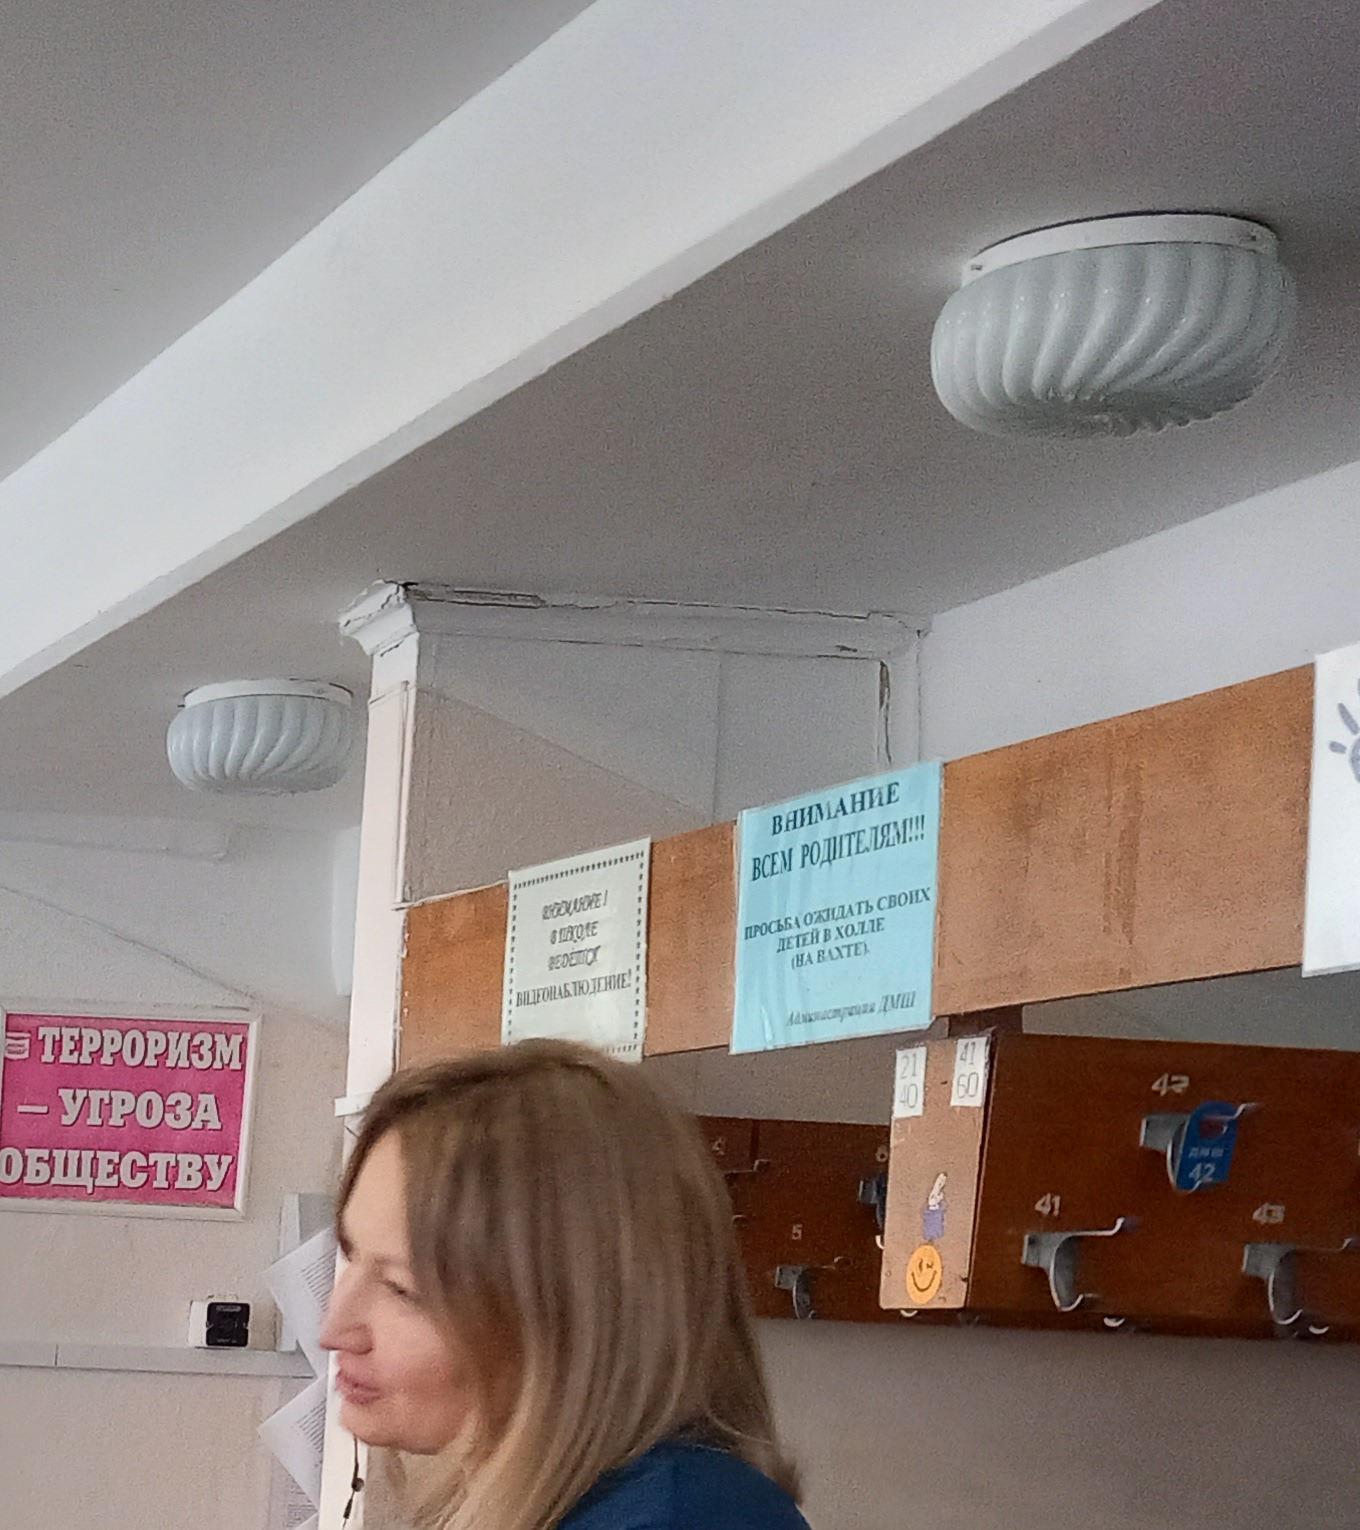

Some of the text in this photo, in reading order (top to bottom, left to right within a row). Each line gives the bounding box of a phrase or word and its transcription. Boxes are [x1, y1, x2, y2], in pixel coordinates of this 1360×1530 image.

[771, 781, 900, 836] ВНИМАНИЕ
[752, 814, 925, 882] ВСЕМ РОДИТЕЛЯМ!!!
[744, 887, 931, 940] ПРОСЬБА ОЖИДАТЬ СВОИХ
[777, 917, 886, 953] ДЕТЕЙ В ХОЛЛЕ
[791, 950, 814, 970] (НА
[38, 1026, 242, 1071] ТЕРРОРИЗМ
[960, 1041, 976, 1065] 41
[900, 1053, 917, 1079] 21
[957, 1072, 979, 1099] 60
[1151, 1073, 1190, 1097] 42
[58, 1088, 222, 1131] УГРОЗА
[1189, 1162, 1216, 1181] 42
[1034, 1192, 1062, 1217] 41
